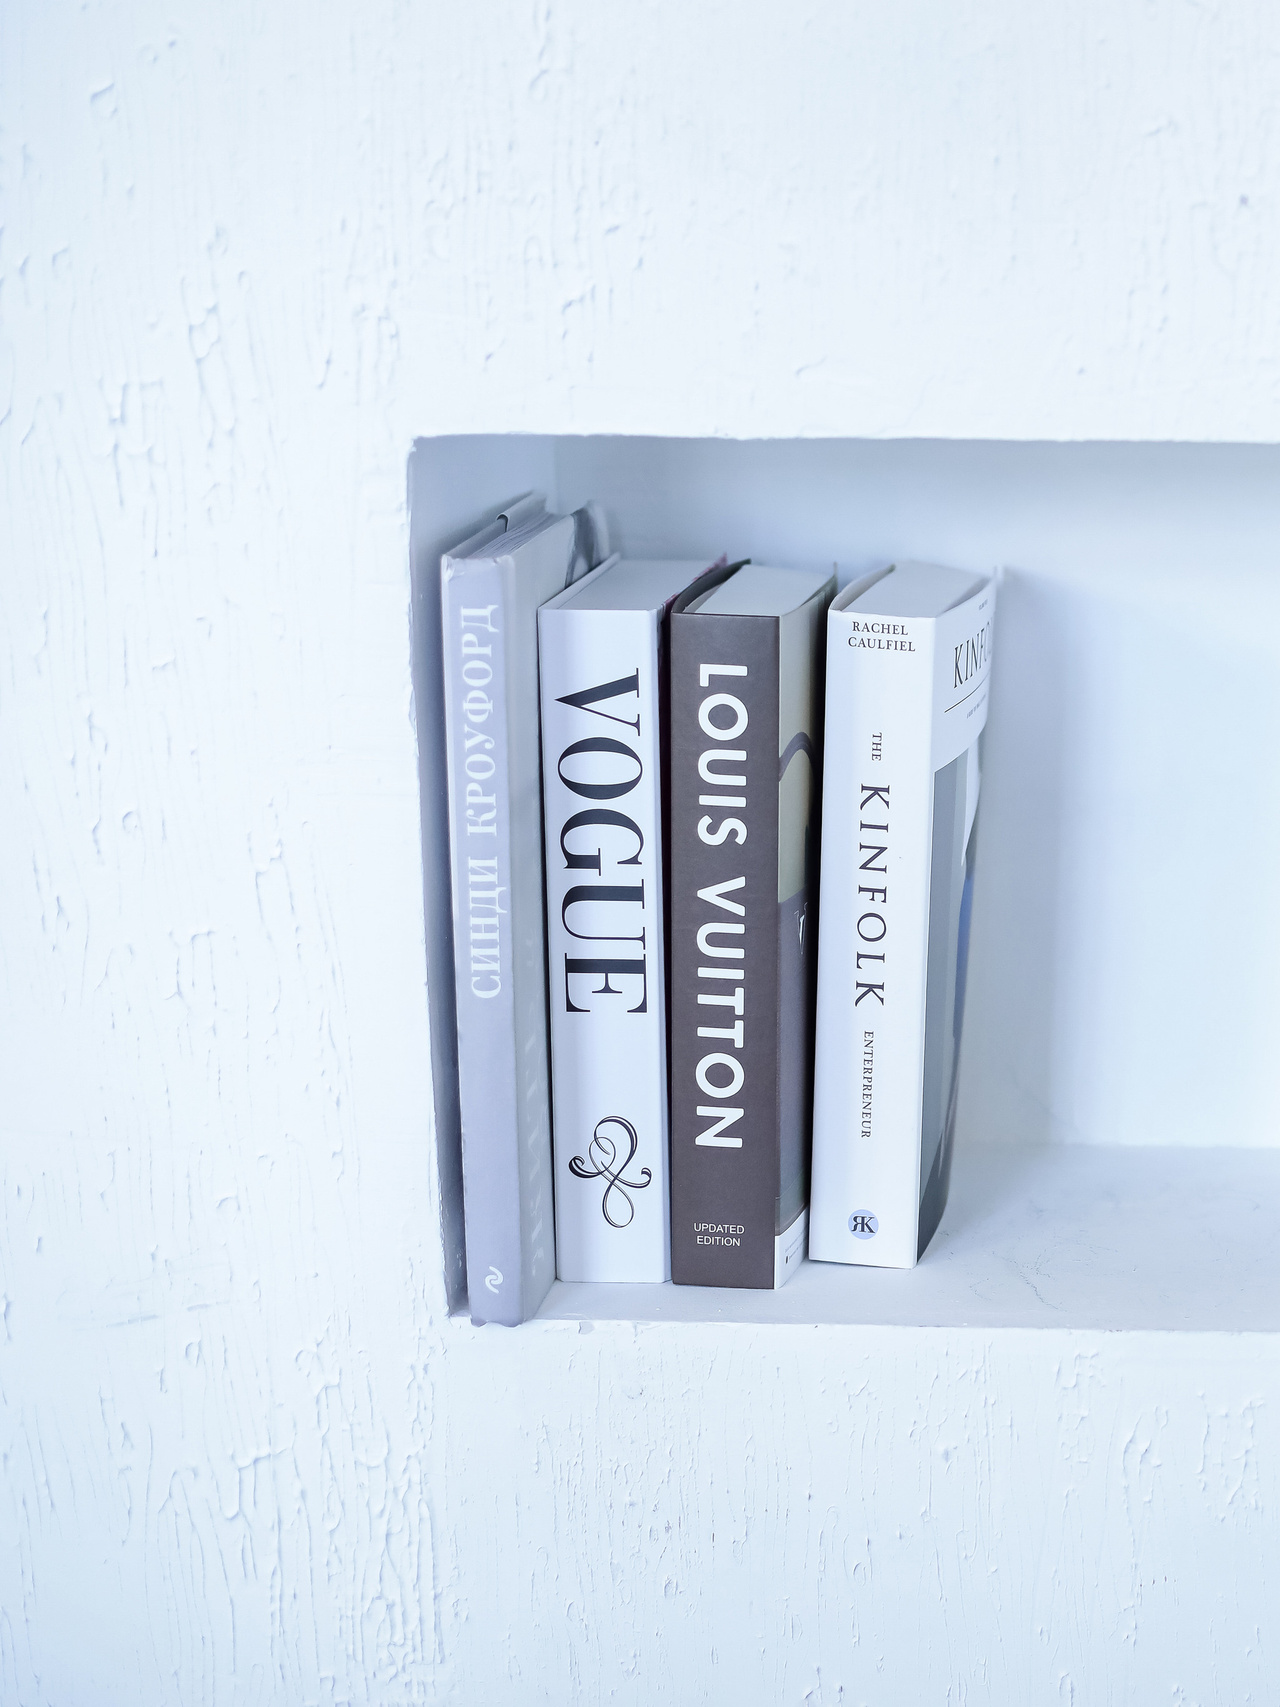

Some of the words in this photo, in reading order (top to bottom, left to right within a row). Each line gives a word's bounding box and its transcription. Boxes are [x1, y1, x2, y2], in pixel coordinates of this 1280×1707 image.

[848, 637, 915, 652] CAULFIEL
[852, 621, 908, 635] RACHEL
[461, 604, 499, 836] КРОУФОРД
[696, 662, 749, 846] LOUIS
[871, 731, 883, 762] THE
[554, 667, 648, 1014] VOGUE
[854, 783, 890, 1008] KINFOLK
[468, 856, 508, 1000] СИНДИ
[695, 876, 746, 1149] VUITTON
[861, 1030, 875, 1140] ENTERPRENEUR
[693, 1222, 745, 1235] UPDATED
[696, 1235, 741, 1247] EDITION
